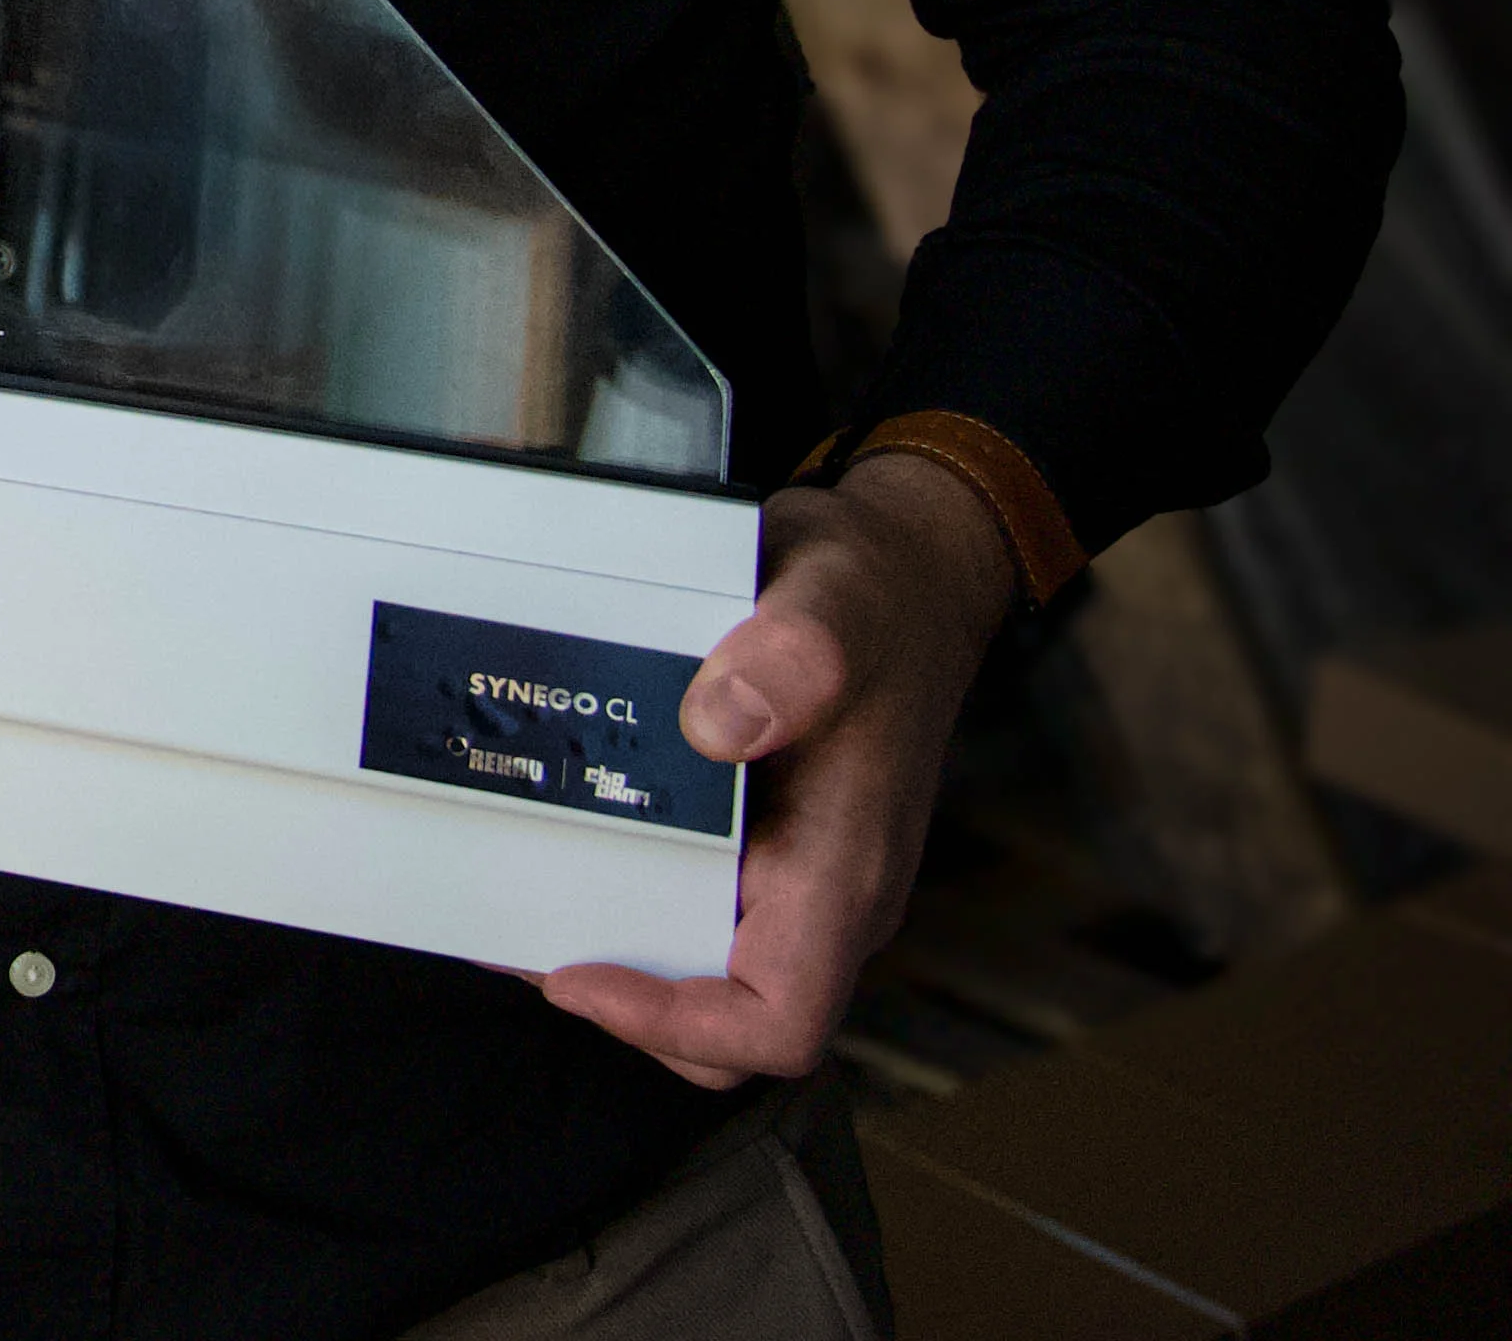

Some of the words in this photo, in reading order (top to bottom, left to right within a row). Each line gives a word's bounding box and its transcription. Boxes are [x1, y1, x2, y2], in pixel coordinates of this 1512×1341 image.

[469, 672, 598, 717] SYNEGO
[605, 698, 637, 725] CL
[468, 748, 544, 782] REHAU
